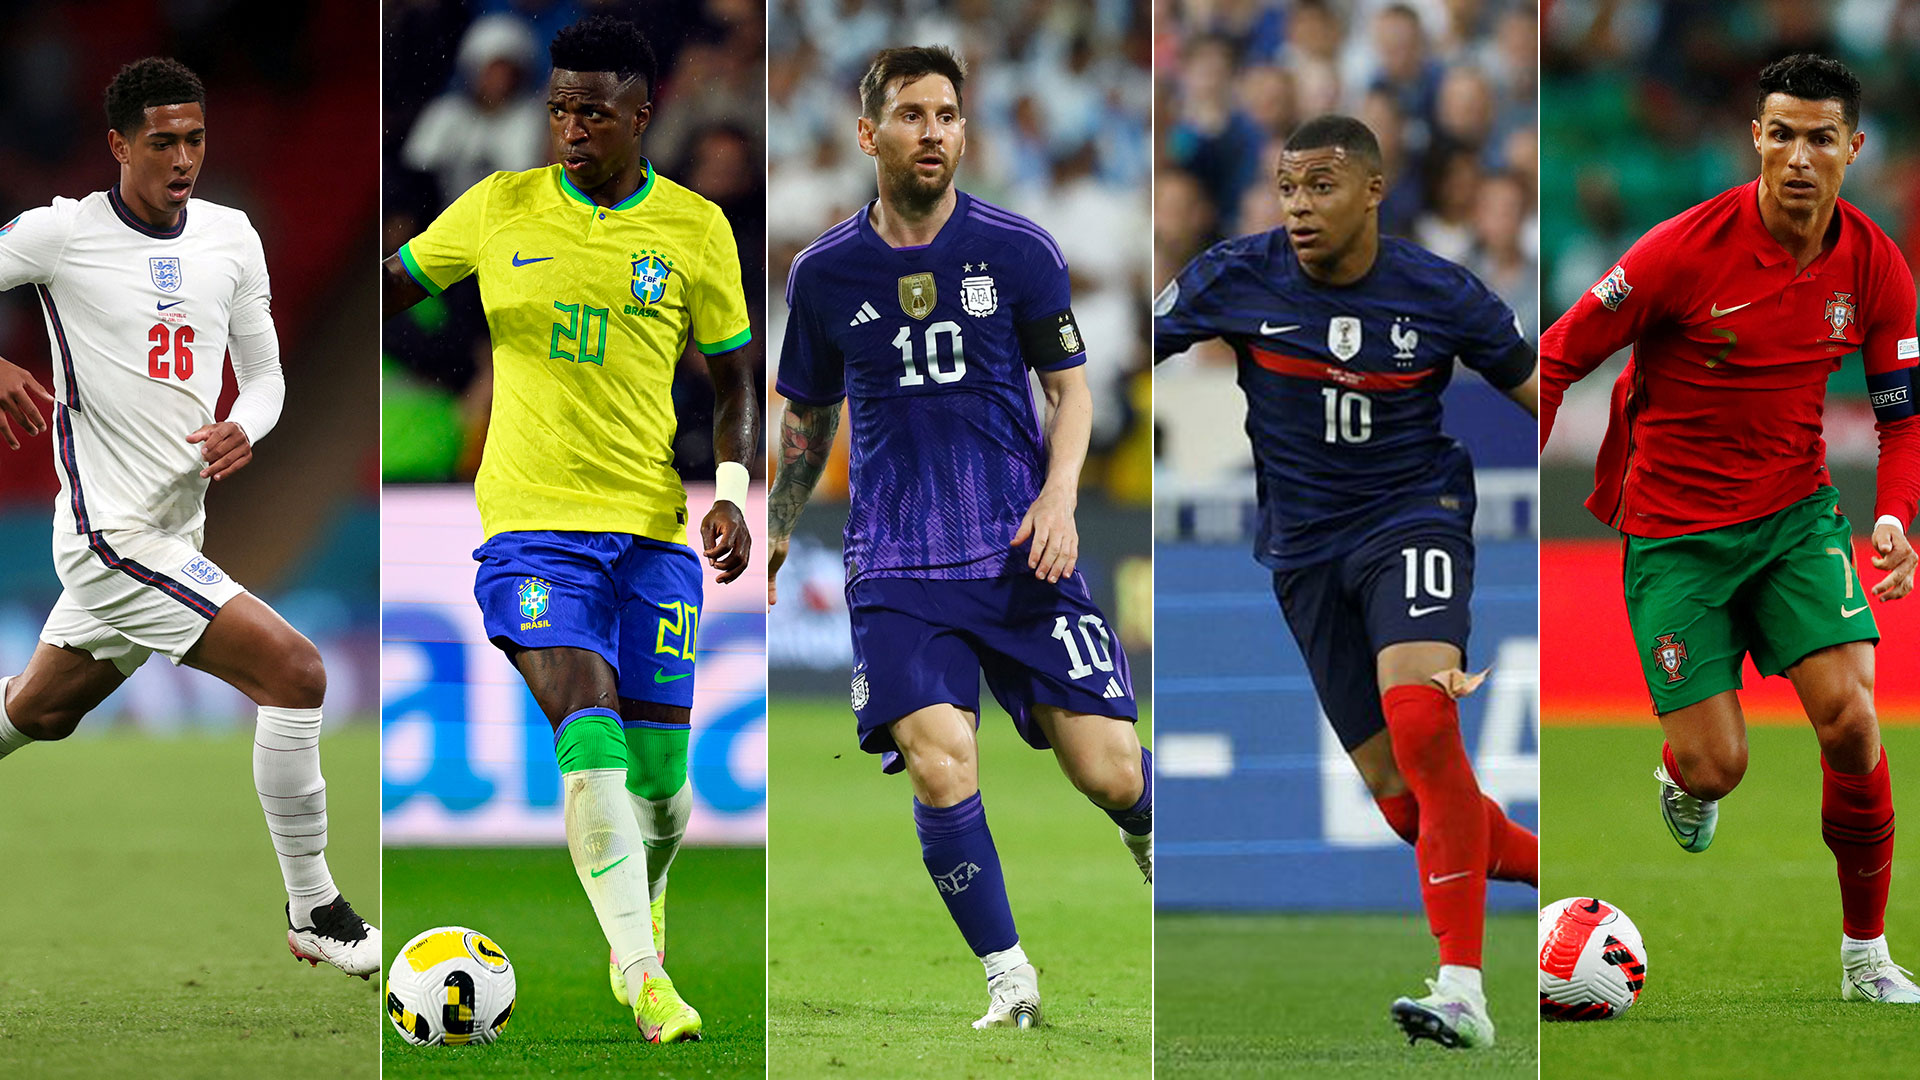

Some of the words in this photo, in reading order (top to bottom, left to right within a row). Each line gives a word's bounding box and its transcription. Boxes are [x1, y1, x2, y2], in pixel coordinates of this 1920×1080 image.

[642, 275, 658, 284] CBF
[970, 287, 990, 306] AFA
[549, 300, 609, 366] 20
[623, 304, 660, 318] BRASIL
[148, 323, 195, 381] 26
[891, 320, 967, 387] 10
[1705, 328, 1738, 369] 7
[1322, 387, 1372, 444] 10
[1871, 389, 1908, 405] RESPECT
[1402, 547, 1453, 600] 10
[1825, 547, 1854, 599] 7
[520, 619, 551, 631] BRASIL
[655, 600, 699, 663] 20
[1050, 614, 1114, 680] 10
[934, 861, 982, 896] AFA
